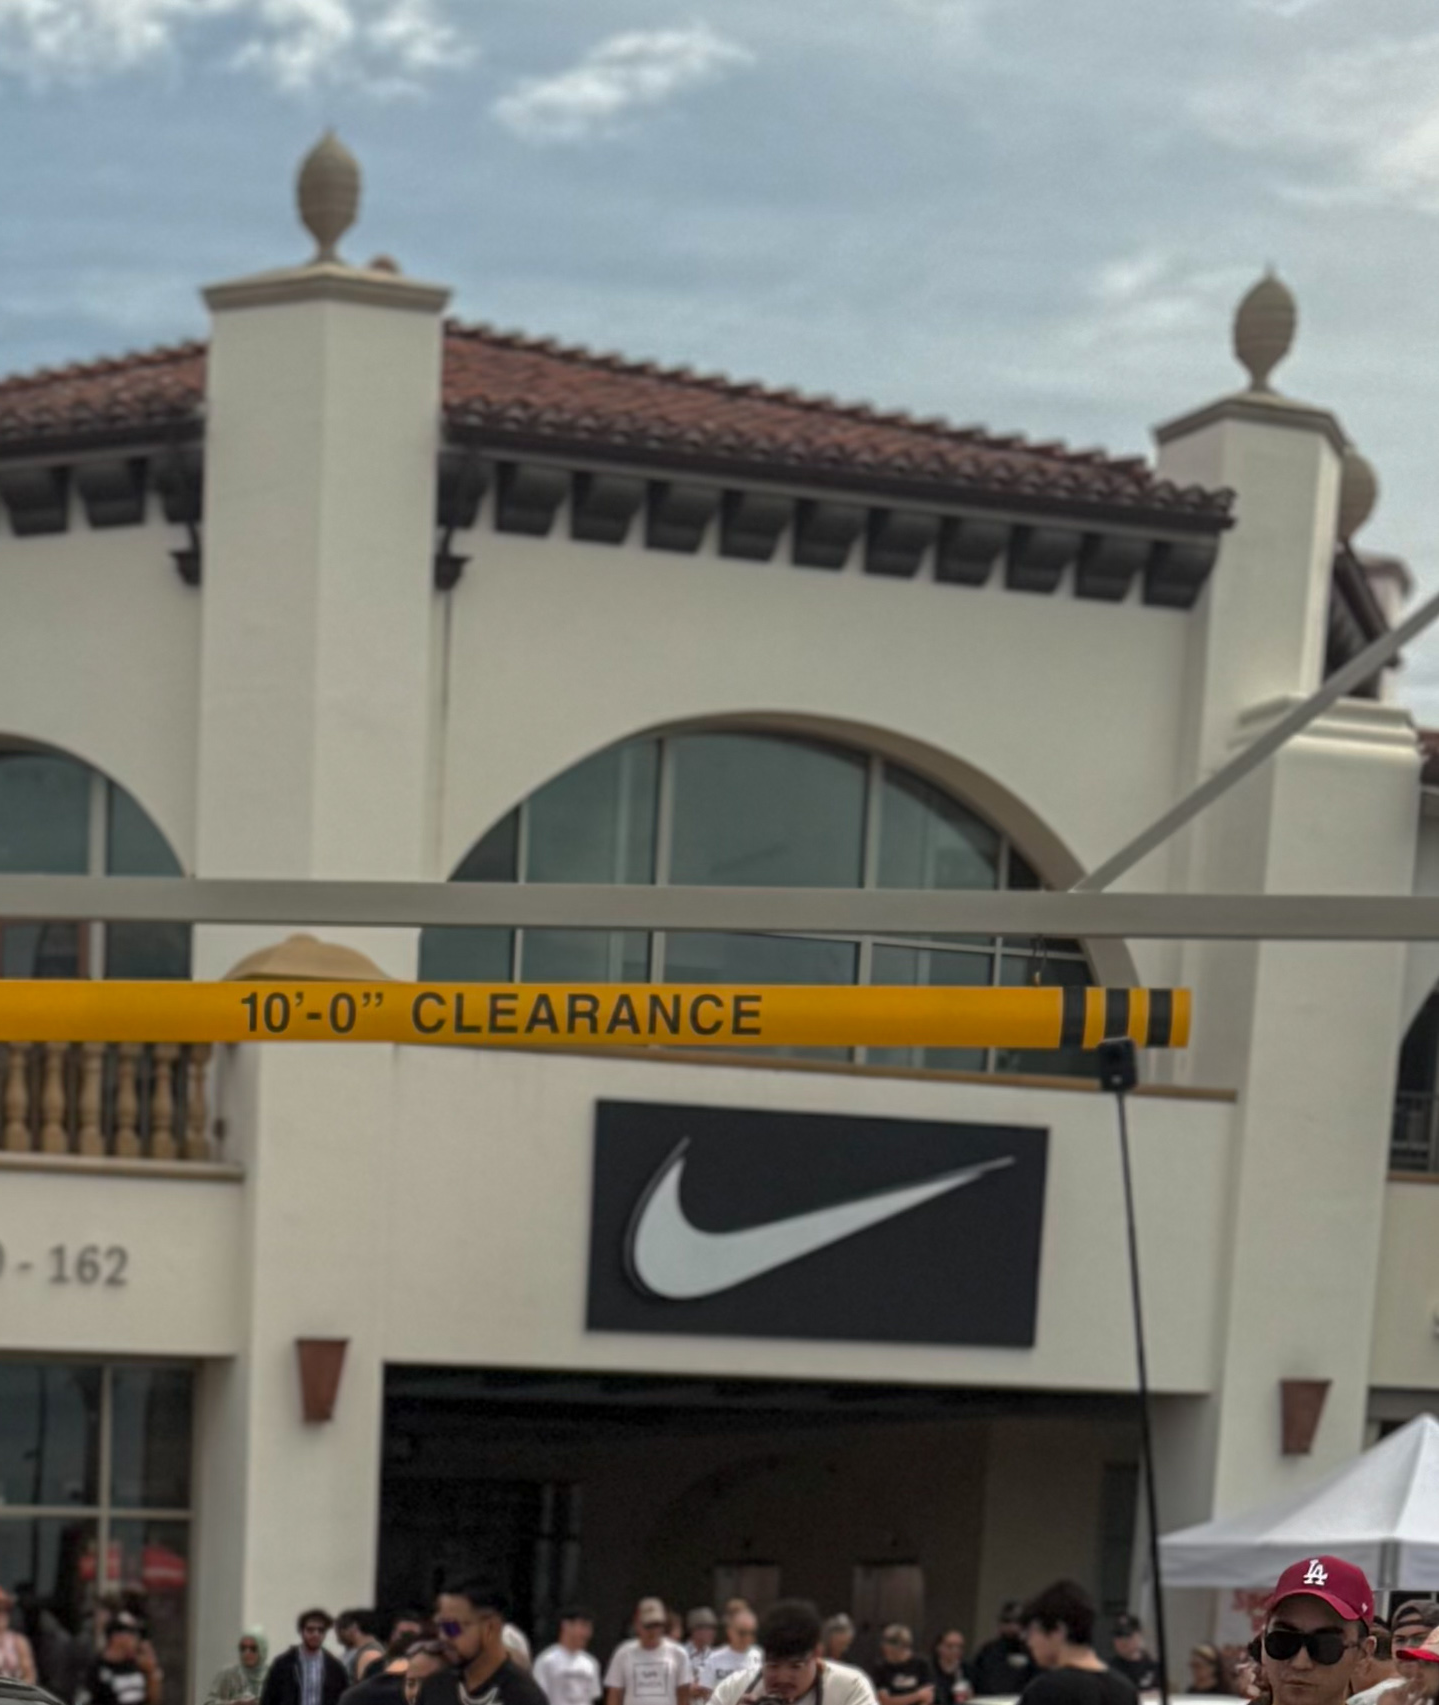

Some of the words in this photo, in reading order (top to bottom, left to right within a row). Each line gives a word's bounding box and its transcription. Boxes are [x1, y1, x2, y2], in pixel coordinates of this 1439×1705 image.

[411, 991, 763, 1037] CLEARANCE
[49, 1245, 128, 1287] 162
[1303, 1559, 1328, 1586] LA
